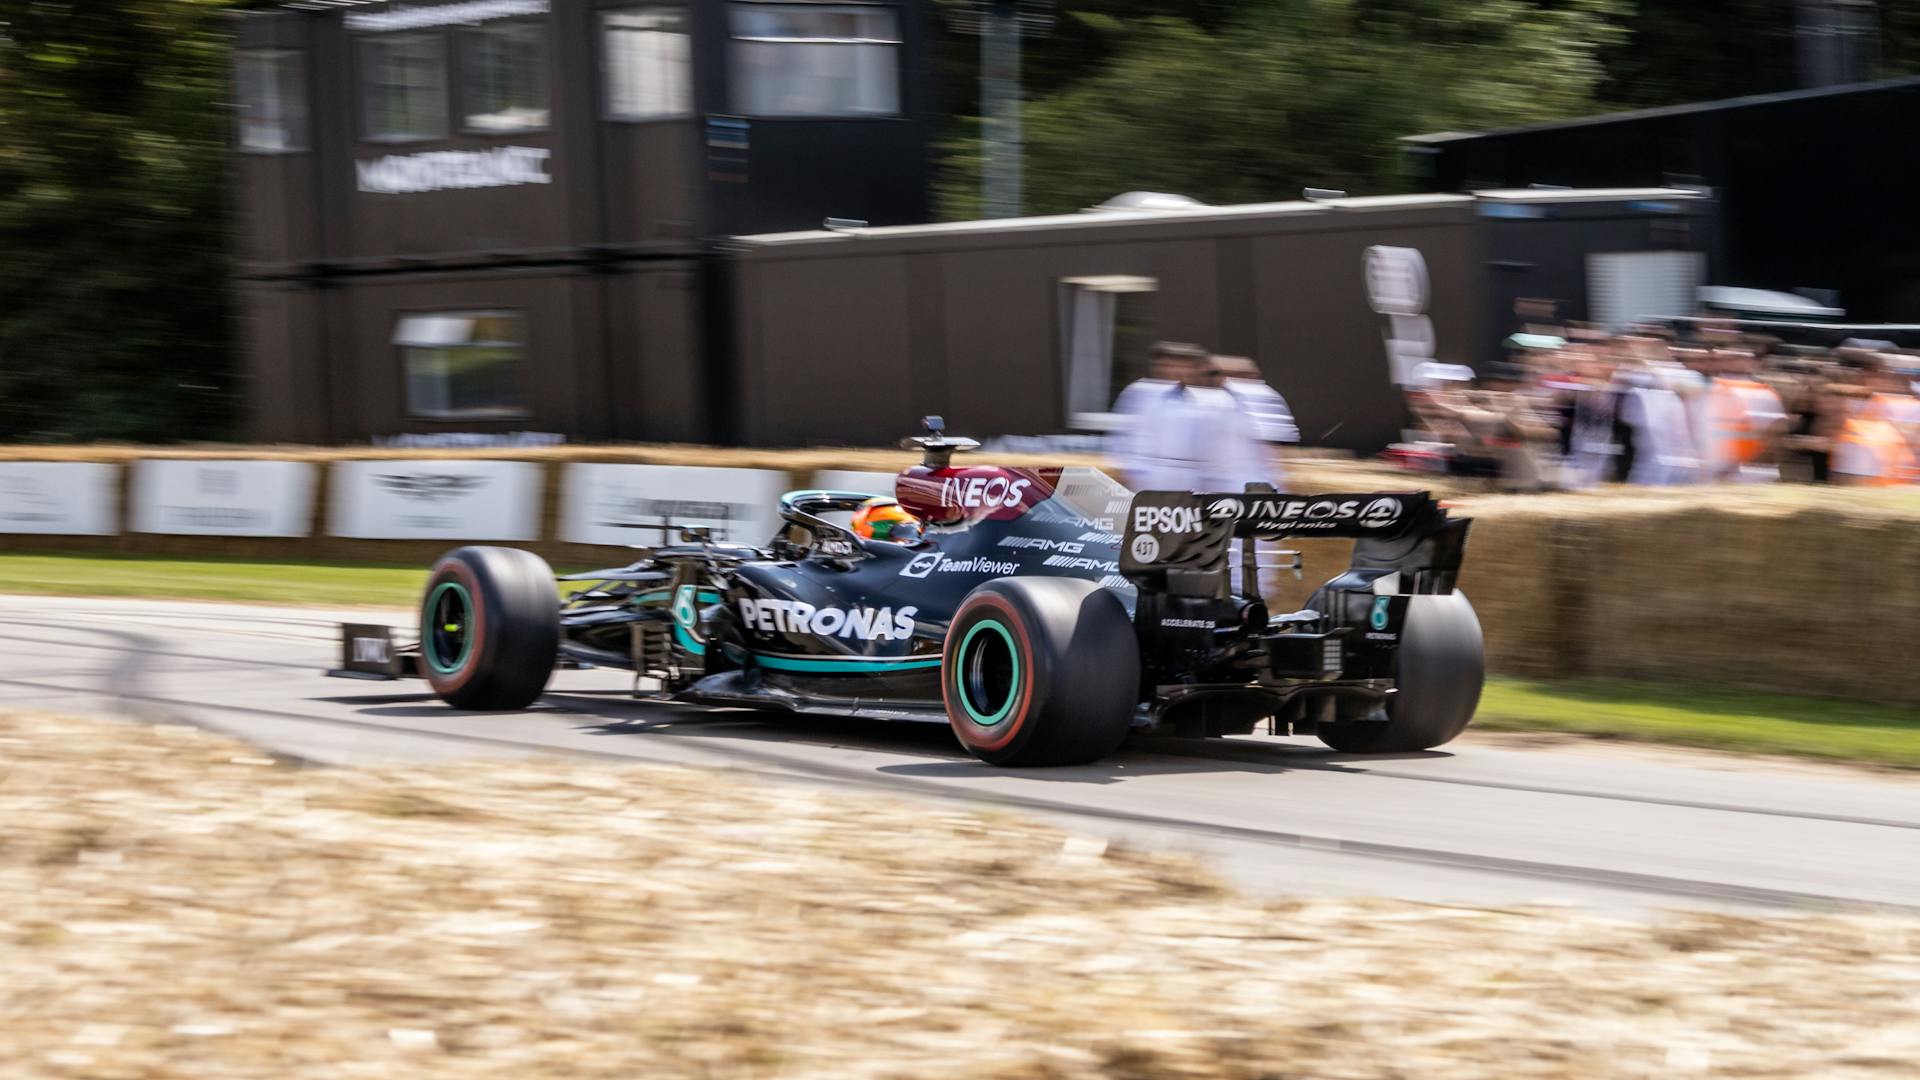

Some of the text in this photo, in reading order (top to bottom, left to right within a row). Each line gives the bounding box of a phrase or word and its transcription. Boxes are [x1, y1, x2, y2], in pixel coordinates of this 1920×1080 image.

[941, 477, 1032, 508] INEOS
[1247, 501, 1360, 519] INEOS
[1059, 517, 1114, 531] AMG
[1135, 506, 1203, 533] EPSON
[1023, 538, 1085, 554] AMG
[1136, 541, 1154, 556] 437
[938, 557, 1020, 575] TeamViewer
[739, 598, 918, 640] PETRONAS
